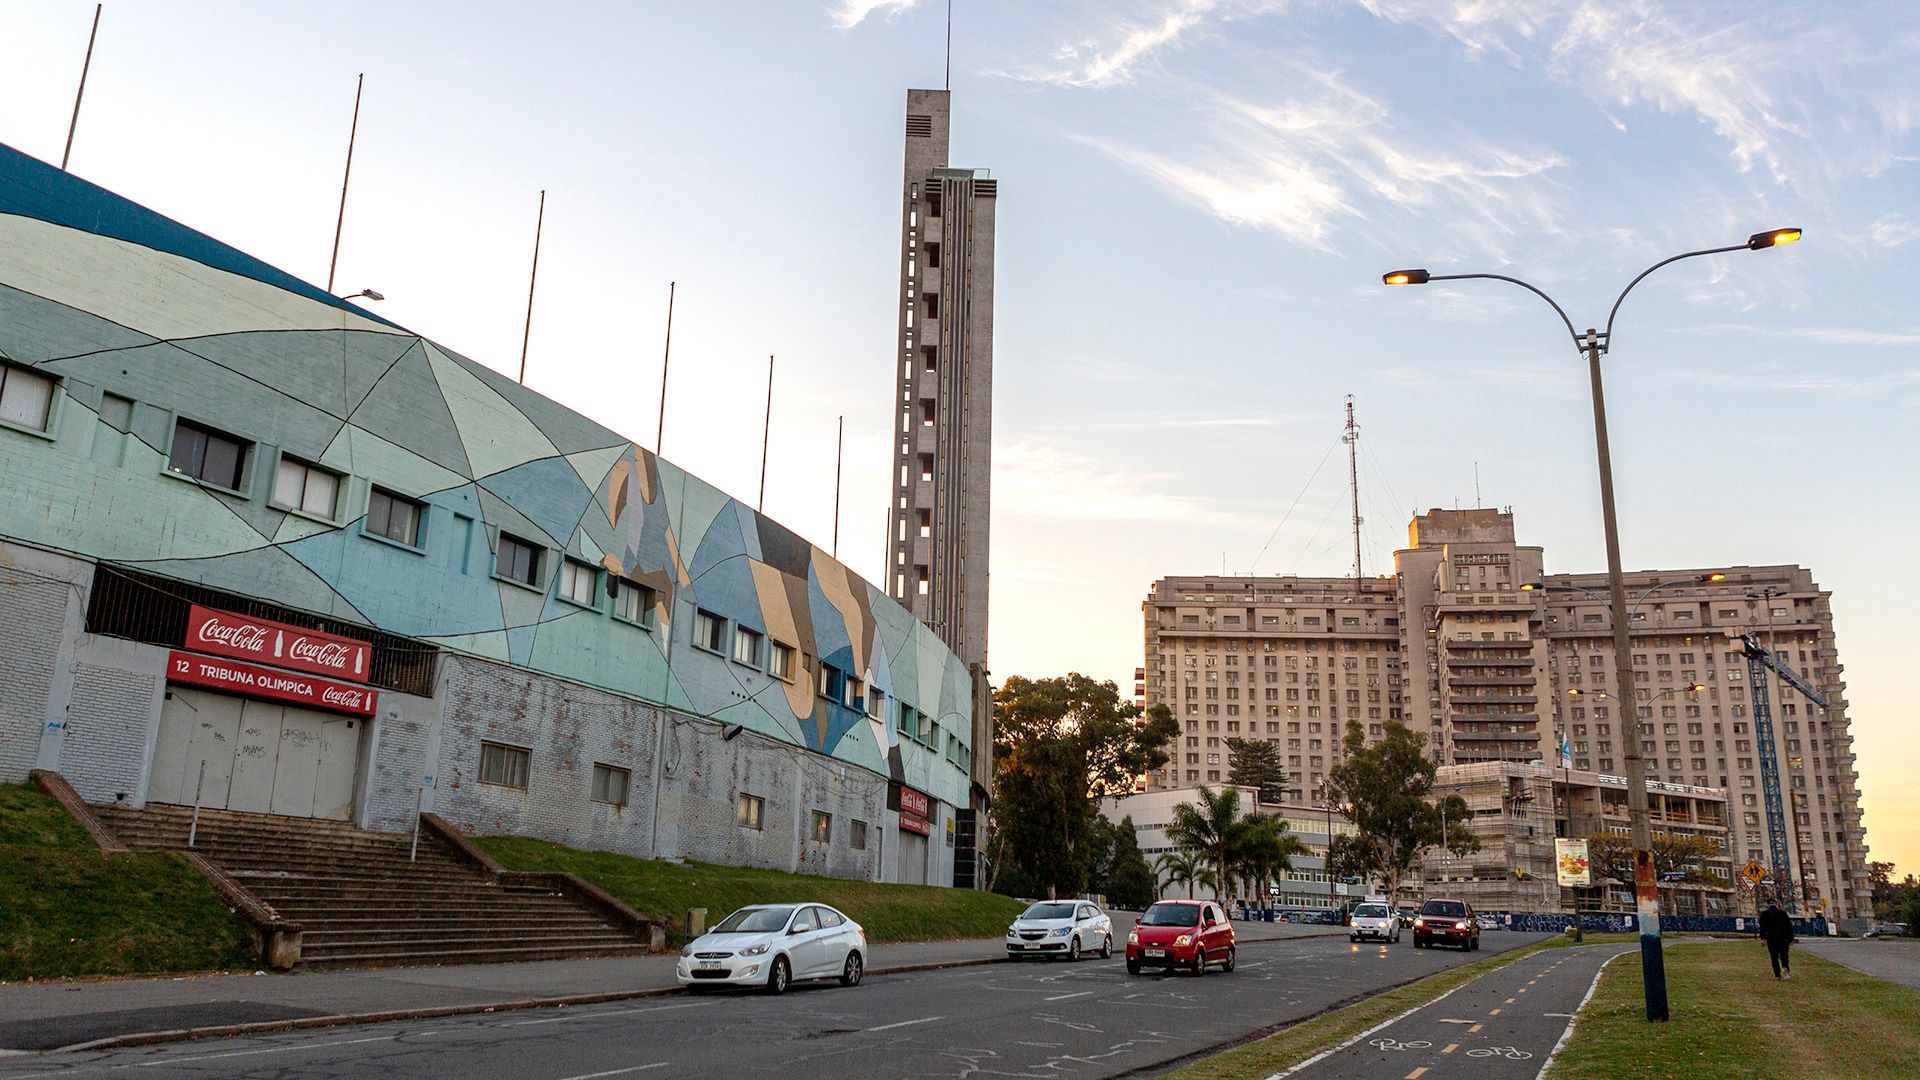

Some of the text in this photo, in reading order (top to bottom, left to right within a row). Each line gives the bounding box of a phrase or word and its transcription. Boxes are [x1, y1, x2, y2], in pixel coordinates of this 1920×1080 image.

[199, 618, 269, 652] Coca-Cola
[290, 636, 351, 669] Coca-Cola
[176, 660, 313, 697] 12 TRIBUNA OLIMPICA
